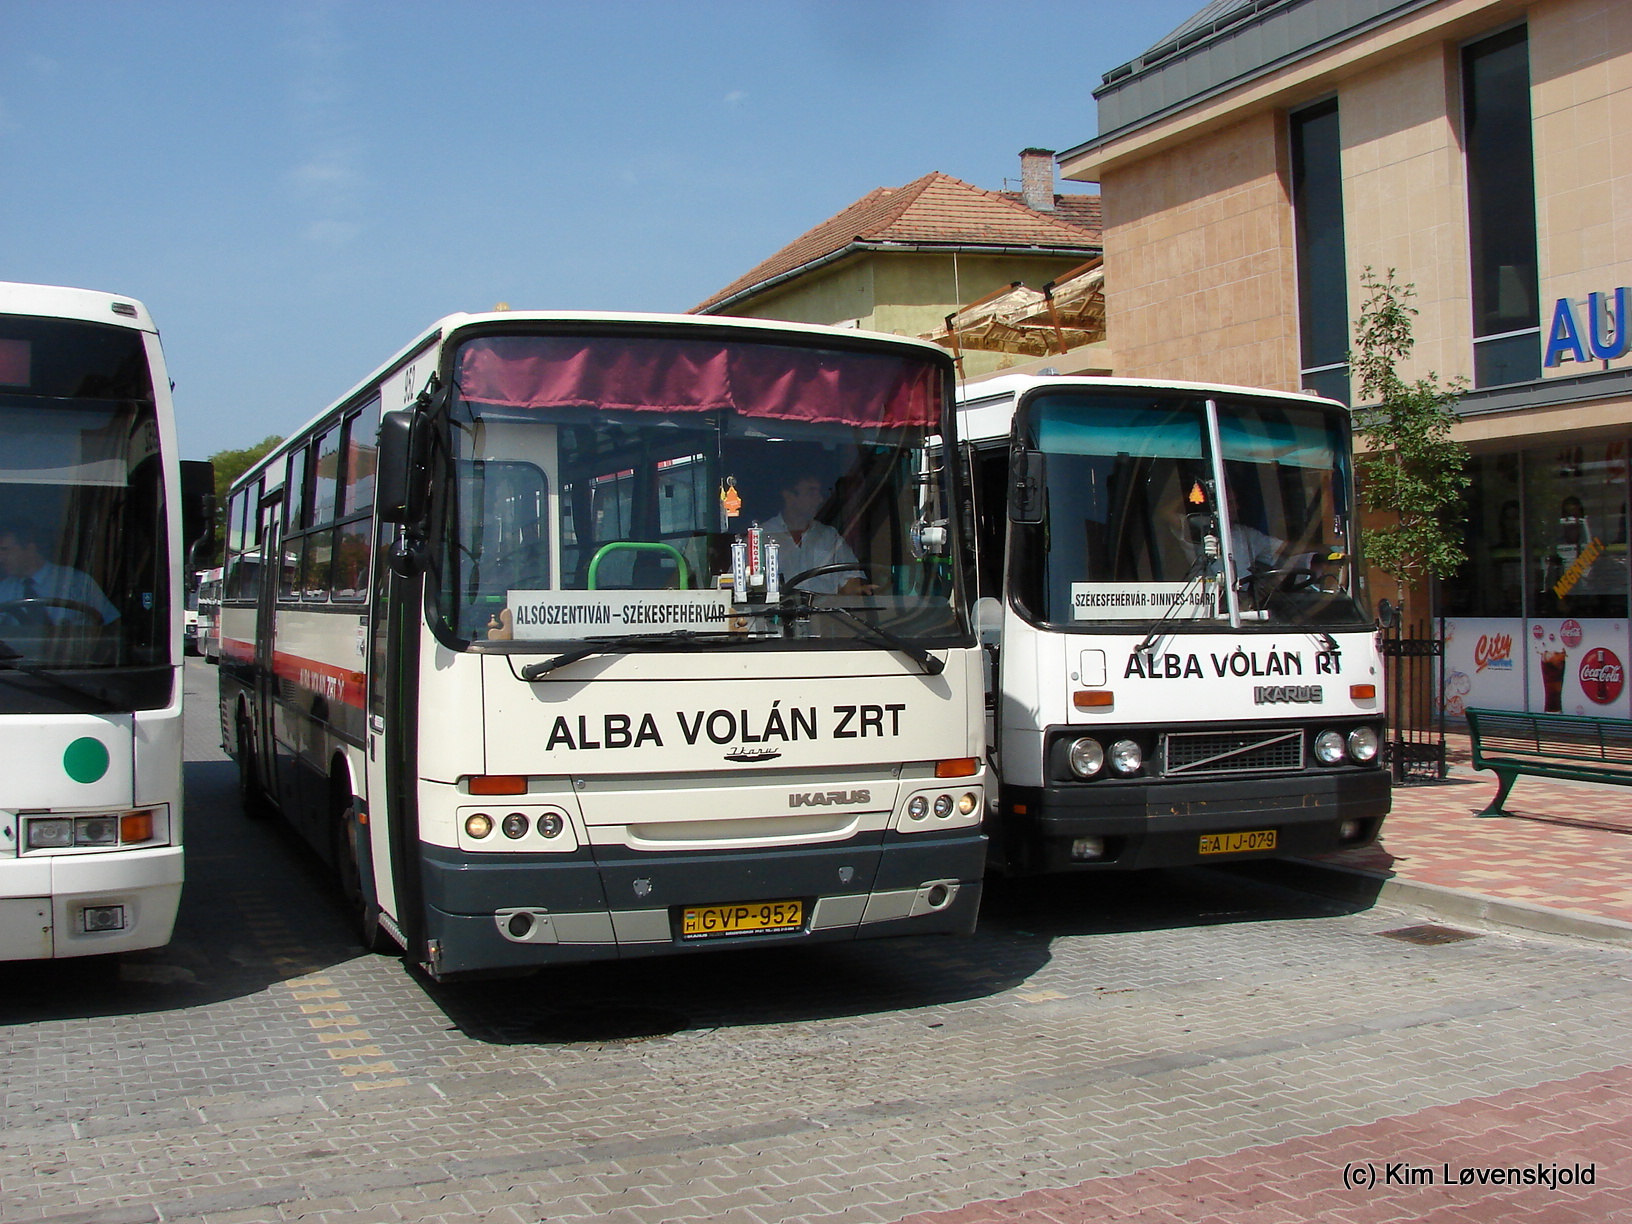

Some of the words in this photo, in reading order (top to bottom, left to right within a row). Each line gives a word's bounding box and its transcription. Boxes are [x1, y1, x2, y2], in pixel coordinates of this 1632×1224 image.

[1475, 633, 1512, 669] City
[1124, 653, 1204, 679] ALBA
[1316, 651, 1342, 675] RT
[1254, 685, 1323, 705] IKARUS
[545, 713, 663, 751] ALBA
[676, 700, 817, 745] VOLÁN
[833, 704, 905, 739] ZRT
[727, 746, 779, 756] Ikarus
[789, 789, 870, 808] IKARUS
[1212, 832, 1275, 852] AIJ-079
[686, 922, 696, 931] H
[703, 904, 798, 929] GVP-952
